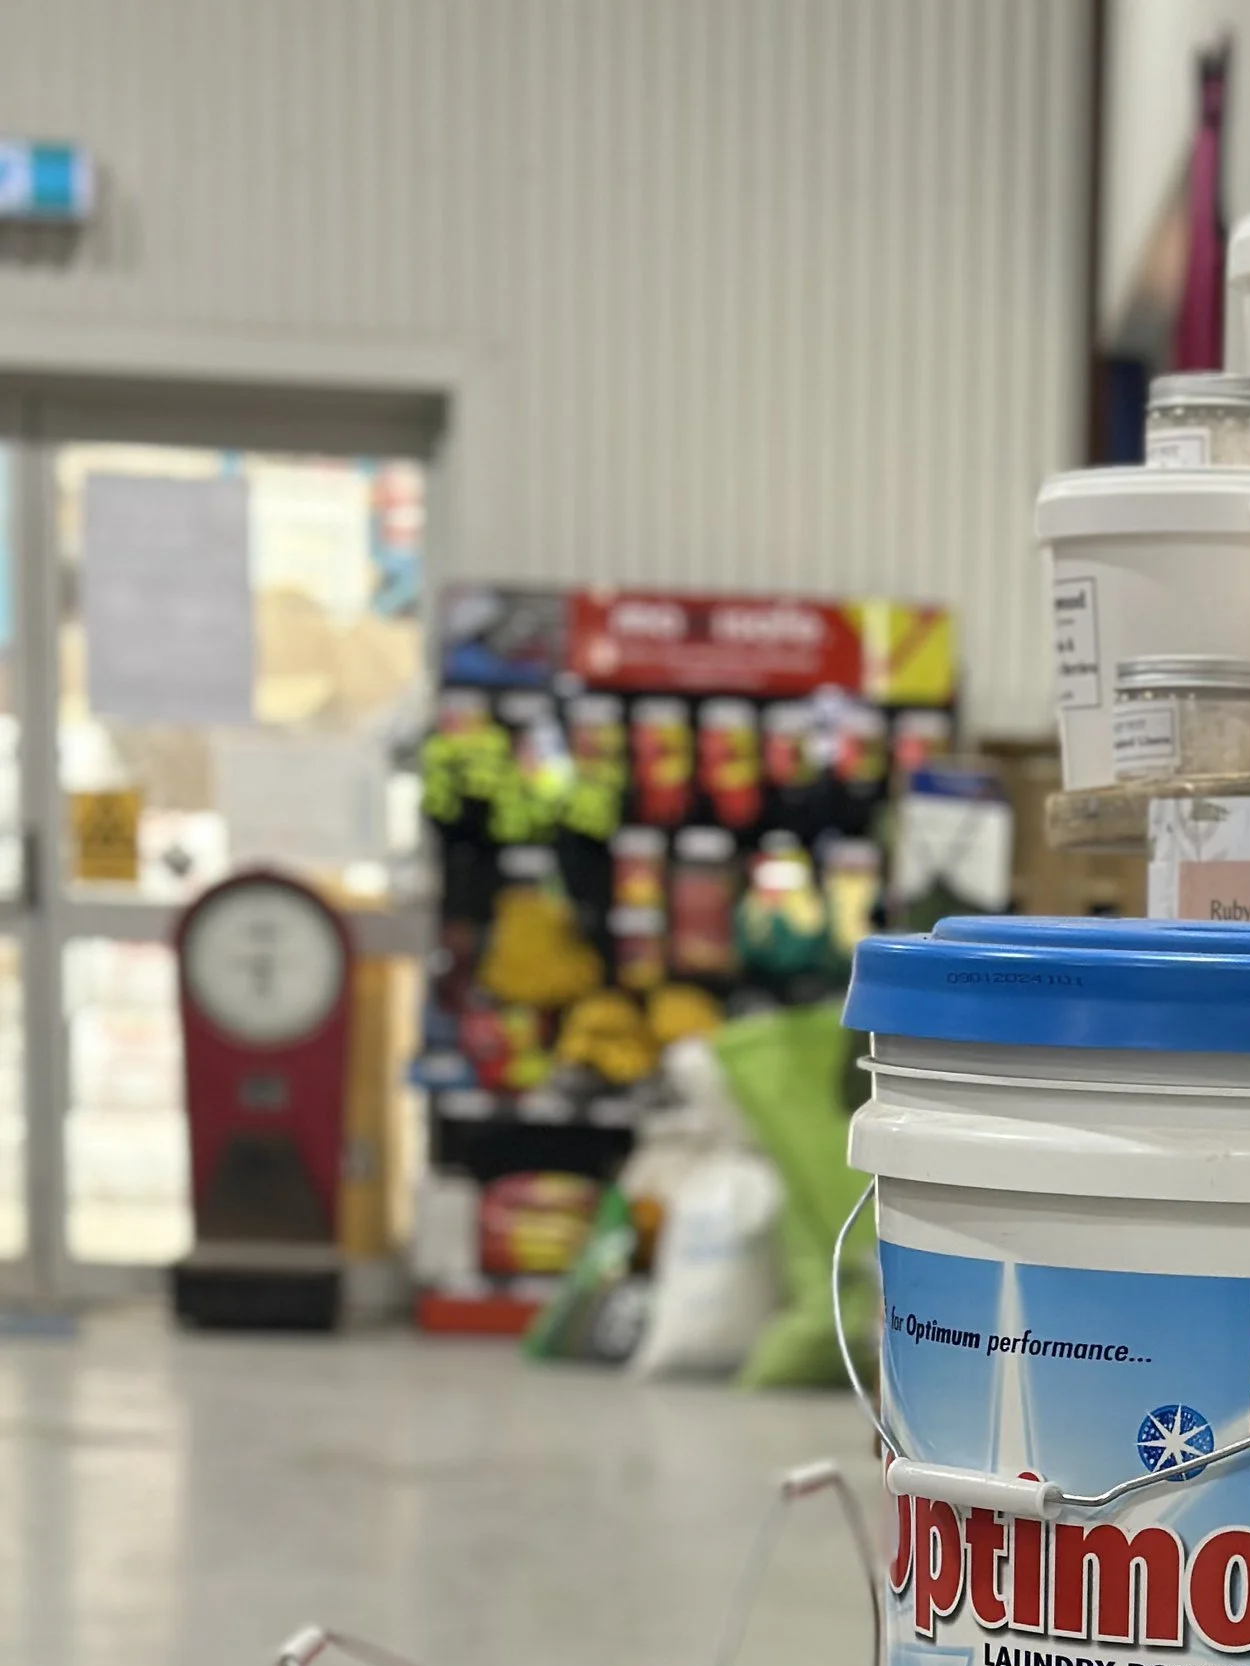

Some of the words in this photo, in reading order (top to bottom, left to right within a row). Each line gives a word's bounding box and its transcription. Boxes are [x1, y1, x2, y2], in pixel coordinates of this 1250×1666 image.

[890, 1306, 904, 1332] for
[906, 1313, 981, 1349] Optimum
[986, 1329, 1152, 1363] performance...
